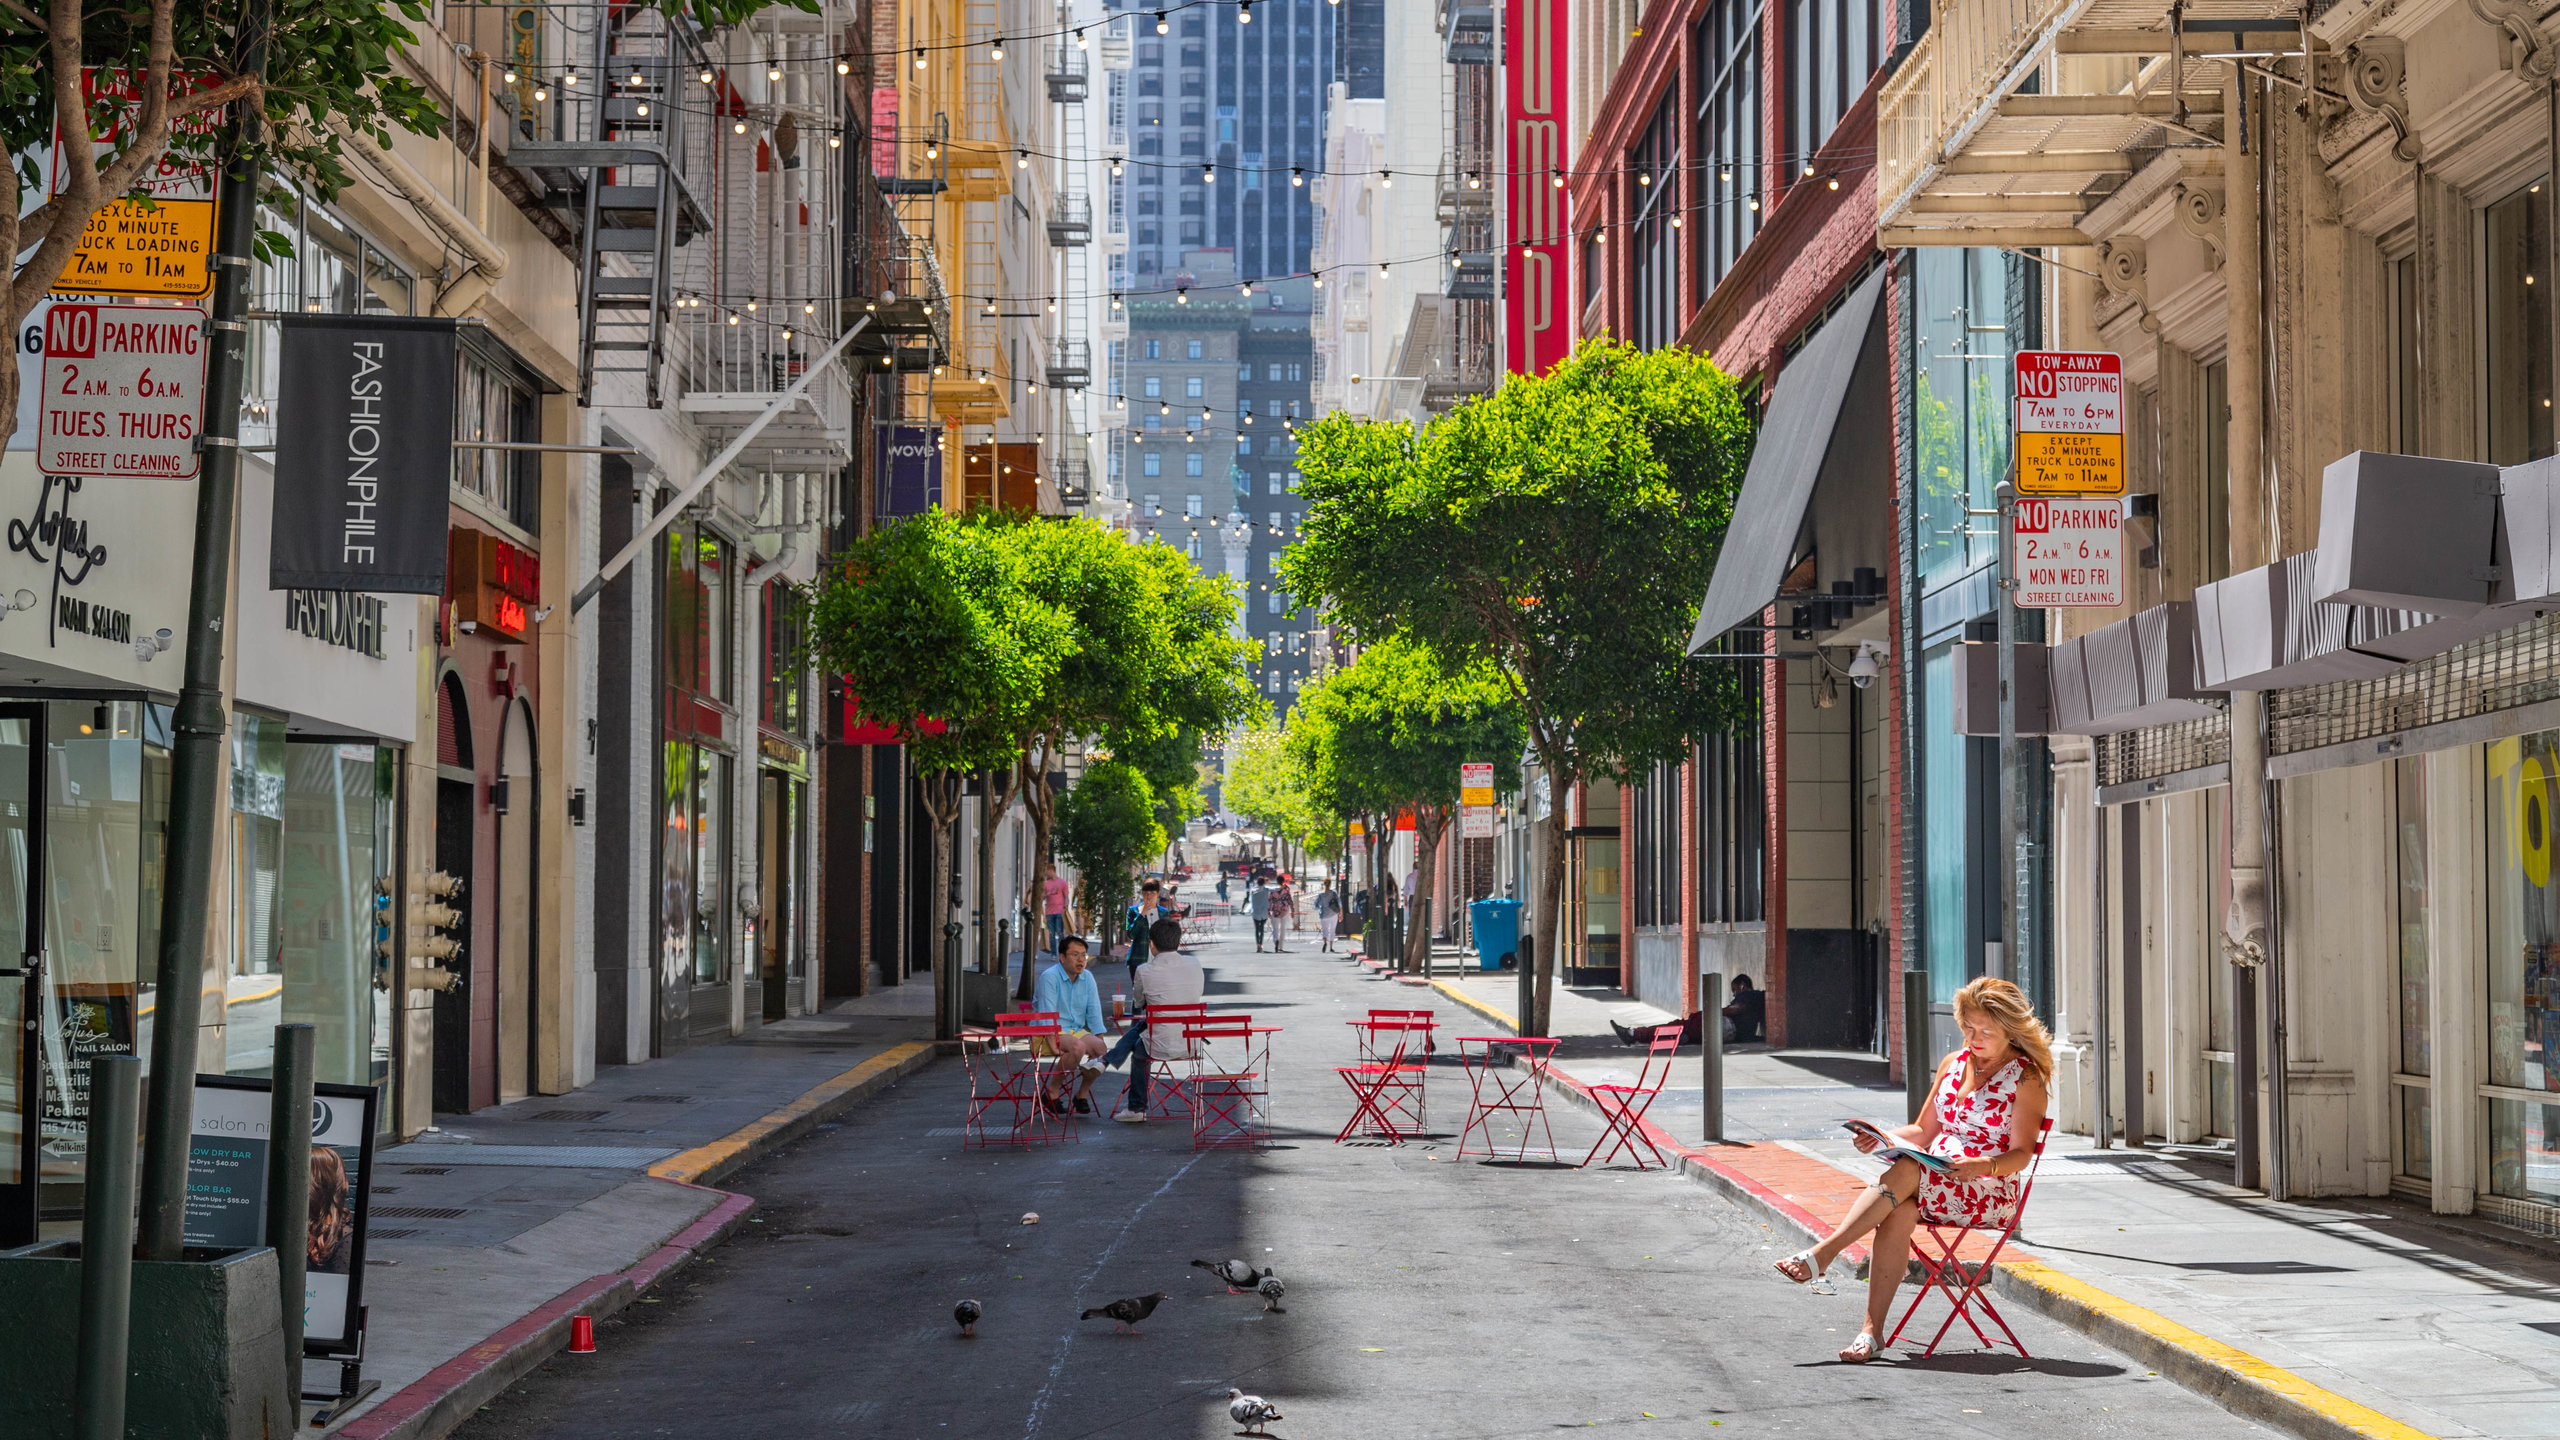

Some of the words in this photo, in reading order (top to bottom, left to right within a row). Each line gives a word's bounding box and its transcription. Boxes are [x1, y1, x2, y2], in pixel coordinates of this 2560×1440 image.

[86, 220, 107, 233] 30
[118, 221, 179, 236] MINUTE
[77, 236, 116, 250] UCK
[126, 238, 200, 253] LOADING
[74, 253, 108, 275] 7AM
[119, 262, 133, 274] TO
[145, 256, 185, 278] 11AM
[51, 310, 92, 353] NO
[102, 322, 198, 355] PARKING
[2034, 356, 2102, 370] TOW-AWAY
[61, 364, 78, 395] 2
[119, 386, 130, 397] TO
[2020, 371, 2053, 396] NO
[2059, 376, 2117, 393] STOPPING
[2027, 401, 2055, 417] 7AM
[2063, 408, 2075, 417] TO
[50, 410, 110, 438] TUES.
[119, 412, 192, 440] THURS
[2041, 421, 2101, 430] EVERYDAY
[2050, 437, 2092, 446] EXCEPT
[344, 341, 384, 565] FASHIONPHILE
[888, 445, 934, 457] wove
[2042, 447, 2056, 456] 30
[2062, 447, 2102, 456] MINUTE
[56, 451, 107, 469] STREET
[113, 453, 180, 471] CLEANING
[2027, 457, 2062, 466] TRUCK
[2068, 457, 2116, 467] LOADING
[2036, 468, 2058, 482] 7AM
[2081, 469, 2108, 482] 11AM
[2018, 502, 2048, 530] NO
[2052, 509, 2118, 529] PARKING
[2026, 539, 2038, 559] 2
[2063, 542, 2071, 550] TO
[2078, 539, 2089, 559] 6
[2029, 568, 2056, 585] MON
[2061, 568, 2086, 585] WED
[2090, 568, 2109, 585] FRI
[2027, 592, 2061, 603] STREET
[2065, 592, 2115, 603] CLEANING
[59, 595, 90, 635] NAIL
[92, 604, 131, 645] SALON
[75, 1044, 98, 1053] NAIL
[100, 1043, 130, 1052] SALON
[201, 1115, 248, 1132] salon
[53, 1142, 86, 1153] Walk-ins
[212, 1149, 230, 1158] DRY
[232, 1151, 252, 1159] BAR
[212, 1186, 232, 1194] BAR
